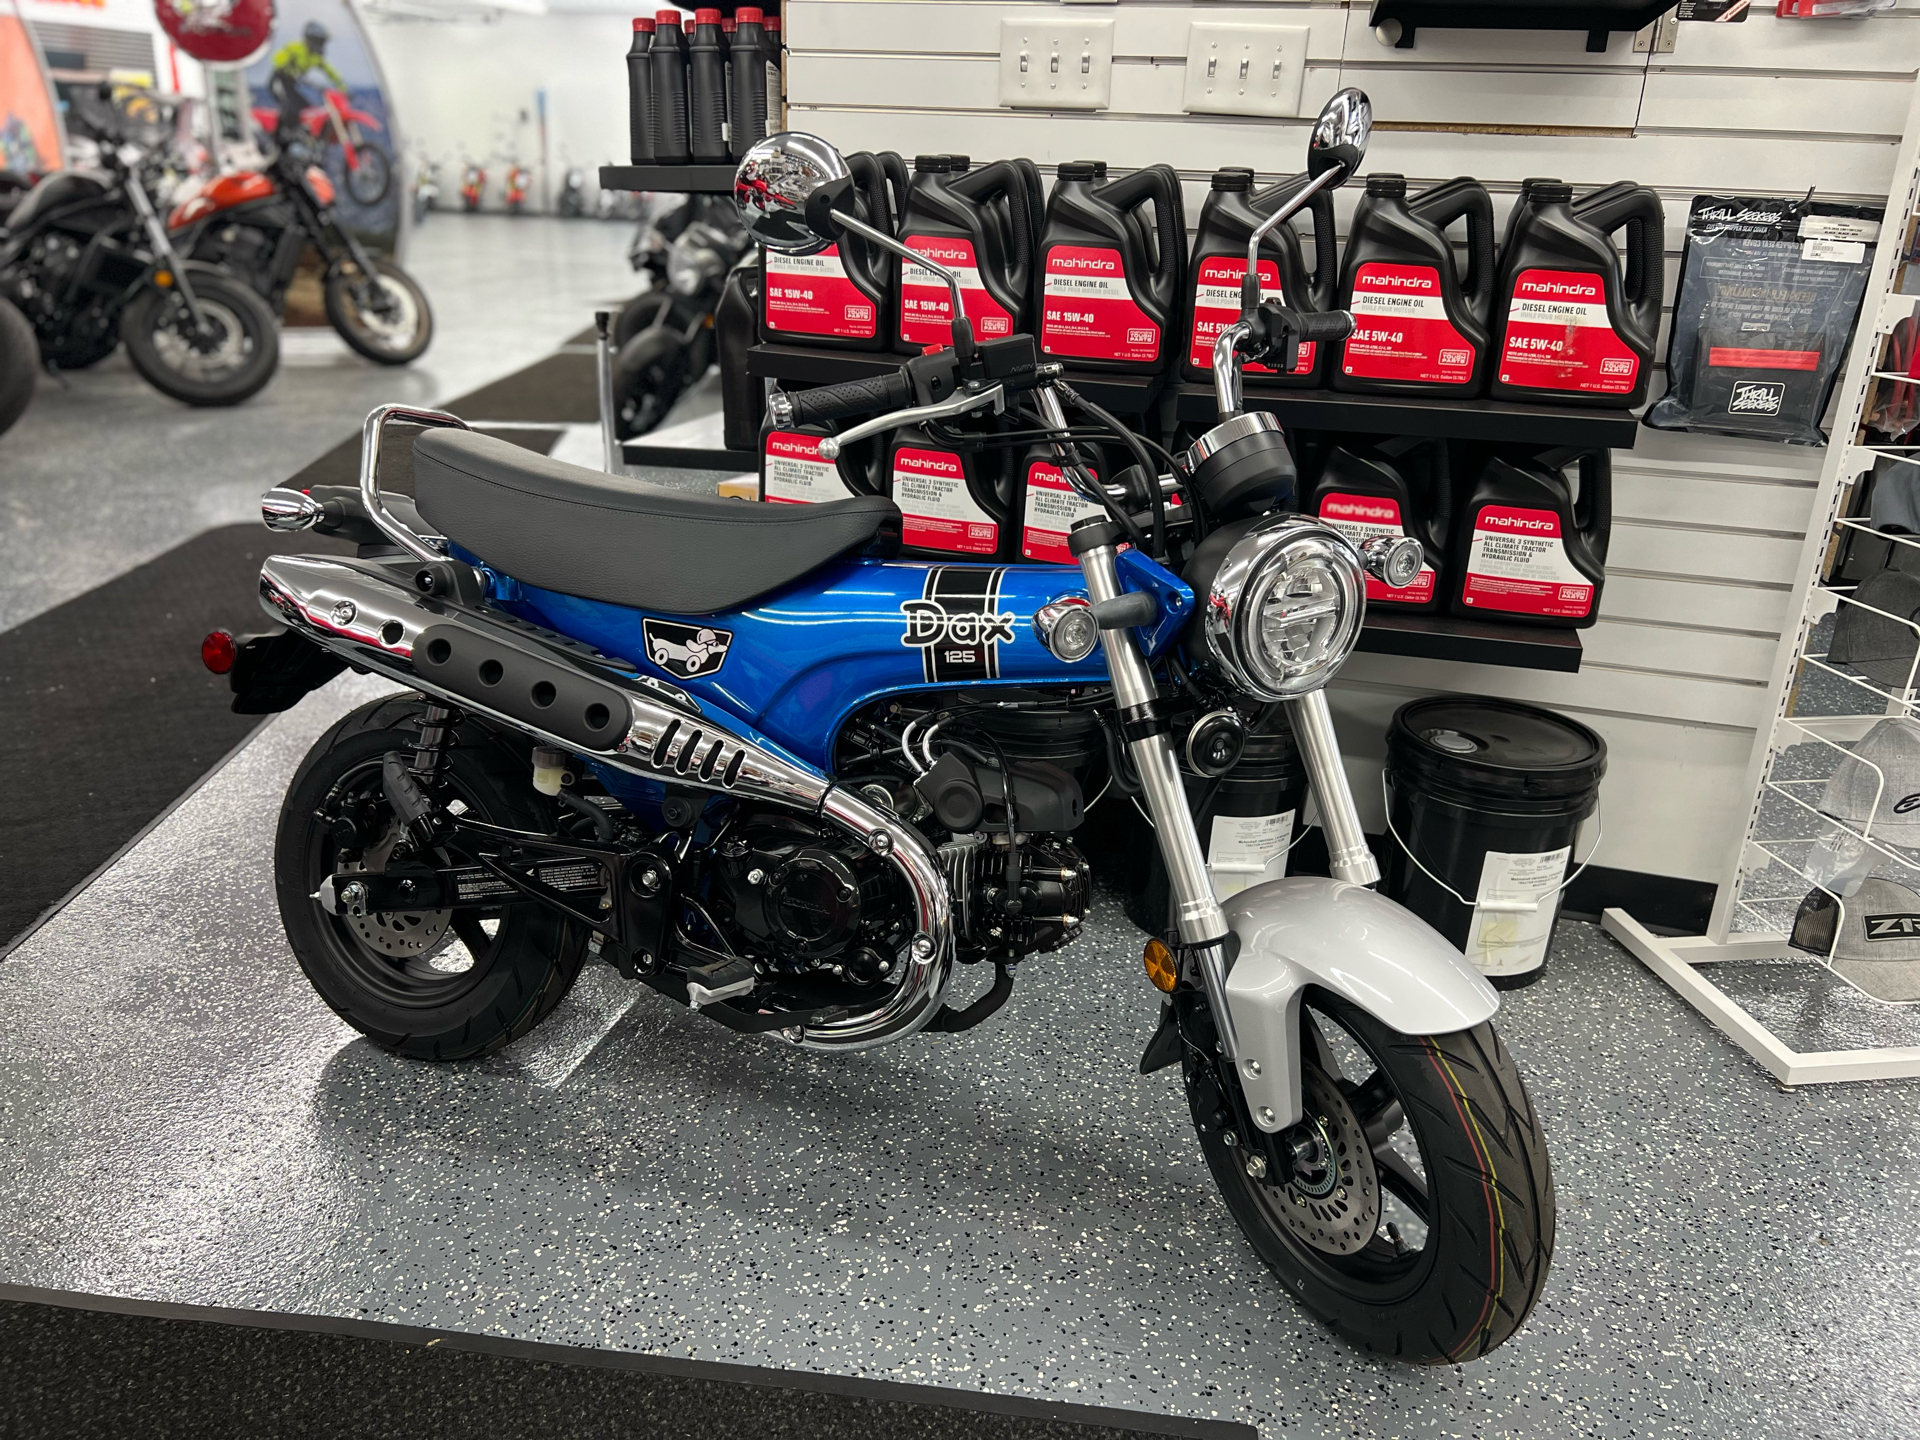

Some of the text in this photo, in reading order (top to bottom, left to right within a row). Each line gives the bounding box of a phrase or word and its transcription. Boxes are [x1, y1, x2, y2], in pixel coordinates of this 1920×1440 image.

[1698, 206, 1782, 224] THRILL SEEKERS
[793, 258, 814, 266] ENGINE
[1052, 258, 1114, 270] mahindra
[1075, 280, 1097, 288] ENGINE
[1362, 275, 1432, 289] mahindra
[770, 287, 813, 300] SAE 15W-40
[1206, 289, 1228, 298] DIESEL
[1522, 282, 1596, 296] mahindra
[904, 299, 949, 312] SAE 15W-40
[1363, 296, 1425, 308] DIESEL ENGINE OIL
[1522, 303, 1587, 316] DIESEL ENGINE OIL
[1046, 310, 1094, 323] SAE 15W-40
[1197, 321, 1213, 333] SAE
[1351, 329, 1403, 343] SAE 5W-40
[1509, 337, 1563, 352] SAE 5W-40
[1736, 385, 1779, 401] THRILL
[1732, 397, 1779, 411] SEEKERS
[772, 442, 819, 455] mahindr
[804, 464, 829, 472] SYNTHETIC
[901, 458, 957, 472] mahindra
[902, 476, 927, 484] UNIVERSAL
[933, 480, 959, 488] SYNTHETIC
[1035, 472, 1066, 484] mahi
[902, 487, 938, 496] TRANSMISSION
[911, 482, 931, 490] CLIMATE
[932, 485, 953, 493] TRACTOR
[1036, 490, 1062, 499] UNIVERSAL
[1035, 502, 1071, 512] TRANSMISSION
[1044, 497, 1065, 505] CLIMATE
[1066, 500, 1088, 508] TRACTOR
[1327, 503, 1394, 519] mahindra
[1485, 516, 1554, 530] mahindra
[1365, 526, 1394, 534] SYNTHETIC
[1485, 535, 1516, 544] UNIVERSAL
[1523, 539, 1554, 548] SYNTHETIC
[1494, 542, 1519, 550] CLIMATE
[1521, 545, 1546, 553] TRACTOR
[1481, 553, 1513, 562] HYDRAULIC
[1483, 547, 1527, 557] TRANSMISSION
[900, 600, 1016, 647] Dax
[944, 650, 976, 663] 125
